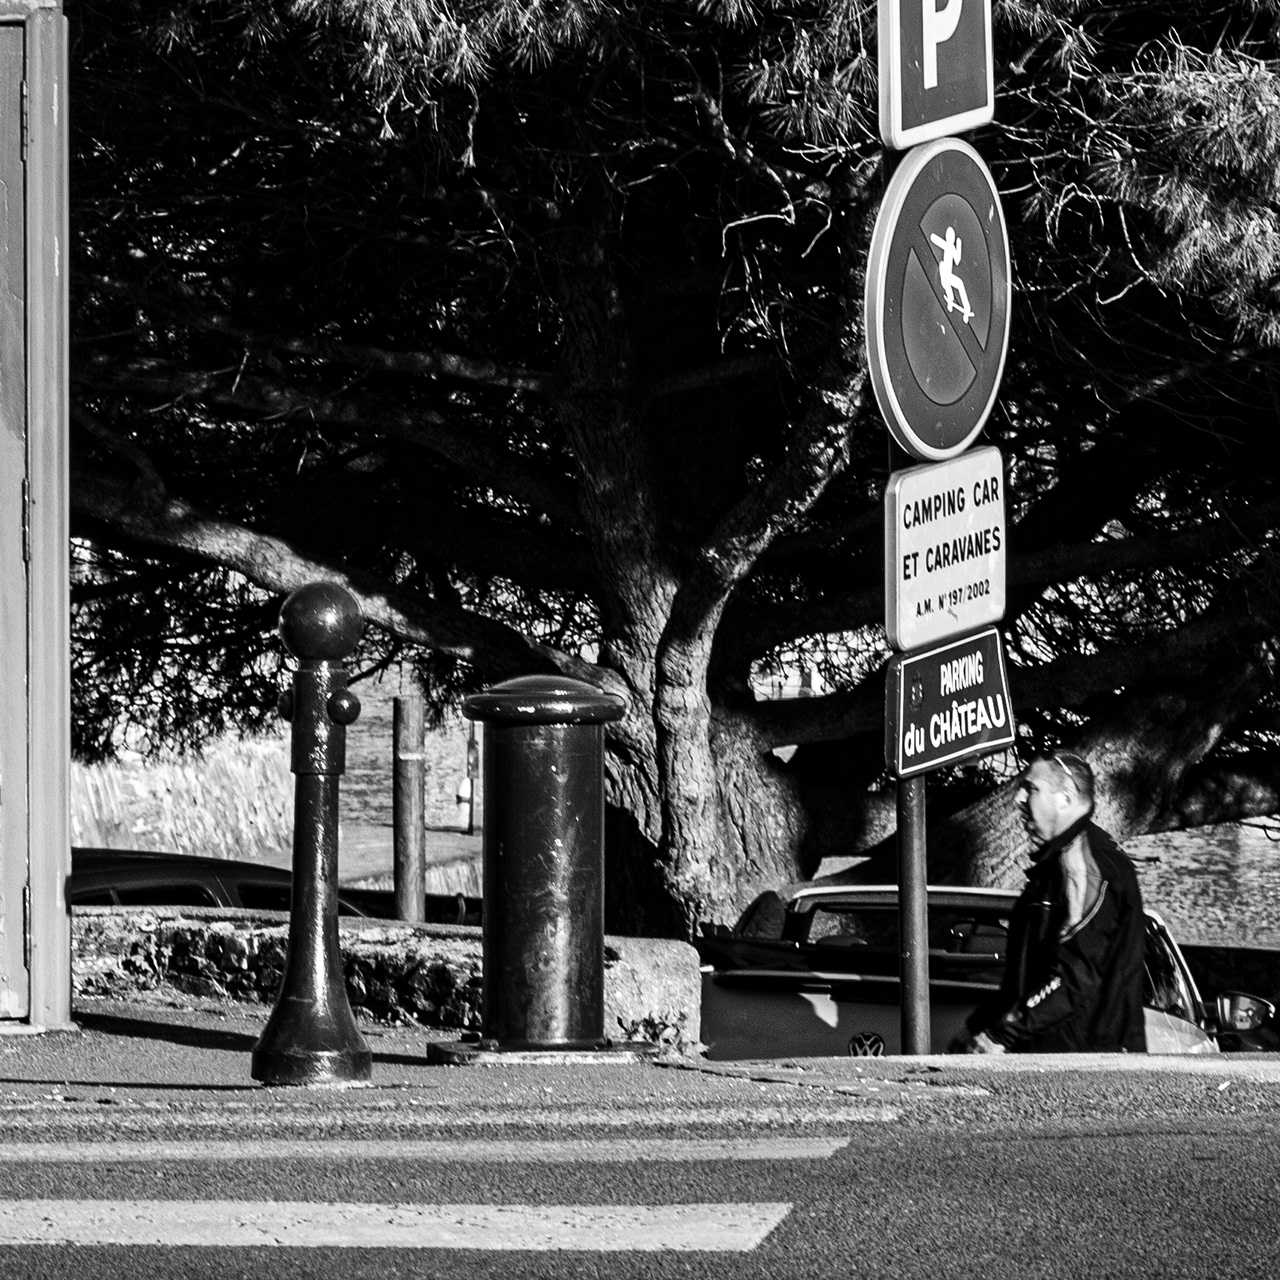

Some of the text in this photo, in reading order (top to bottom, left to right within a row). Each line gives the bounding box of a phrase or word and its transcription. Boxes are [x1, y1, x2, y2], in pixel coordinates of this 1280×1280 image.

[903, 476, 999, 529] CAMPING CAR
[903, 526, 1001, 580] ET CARAVANES
[916, 598, 934, 618] A.M.
[940, 650, 983, 697] PARKING
[904, 693, 1006, 757] du CHÂTEAU
